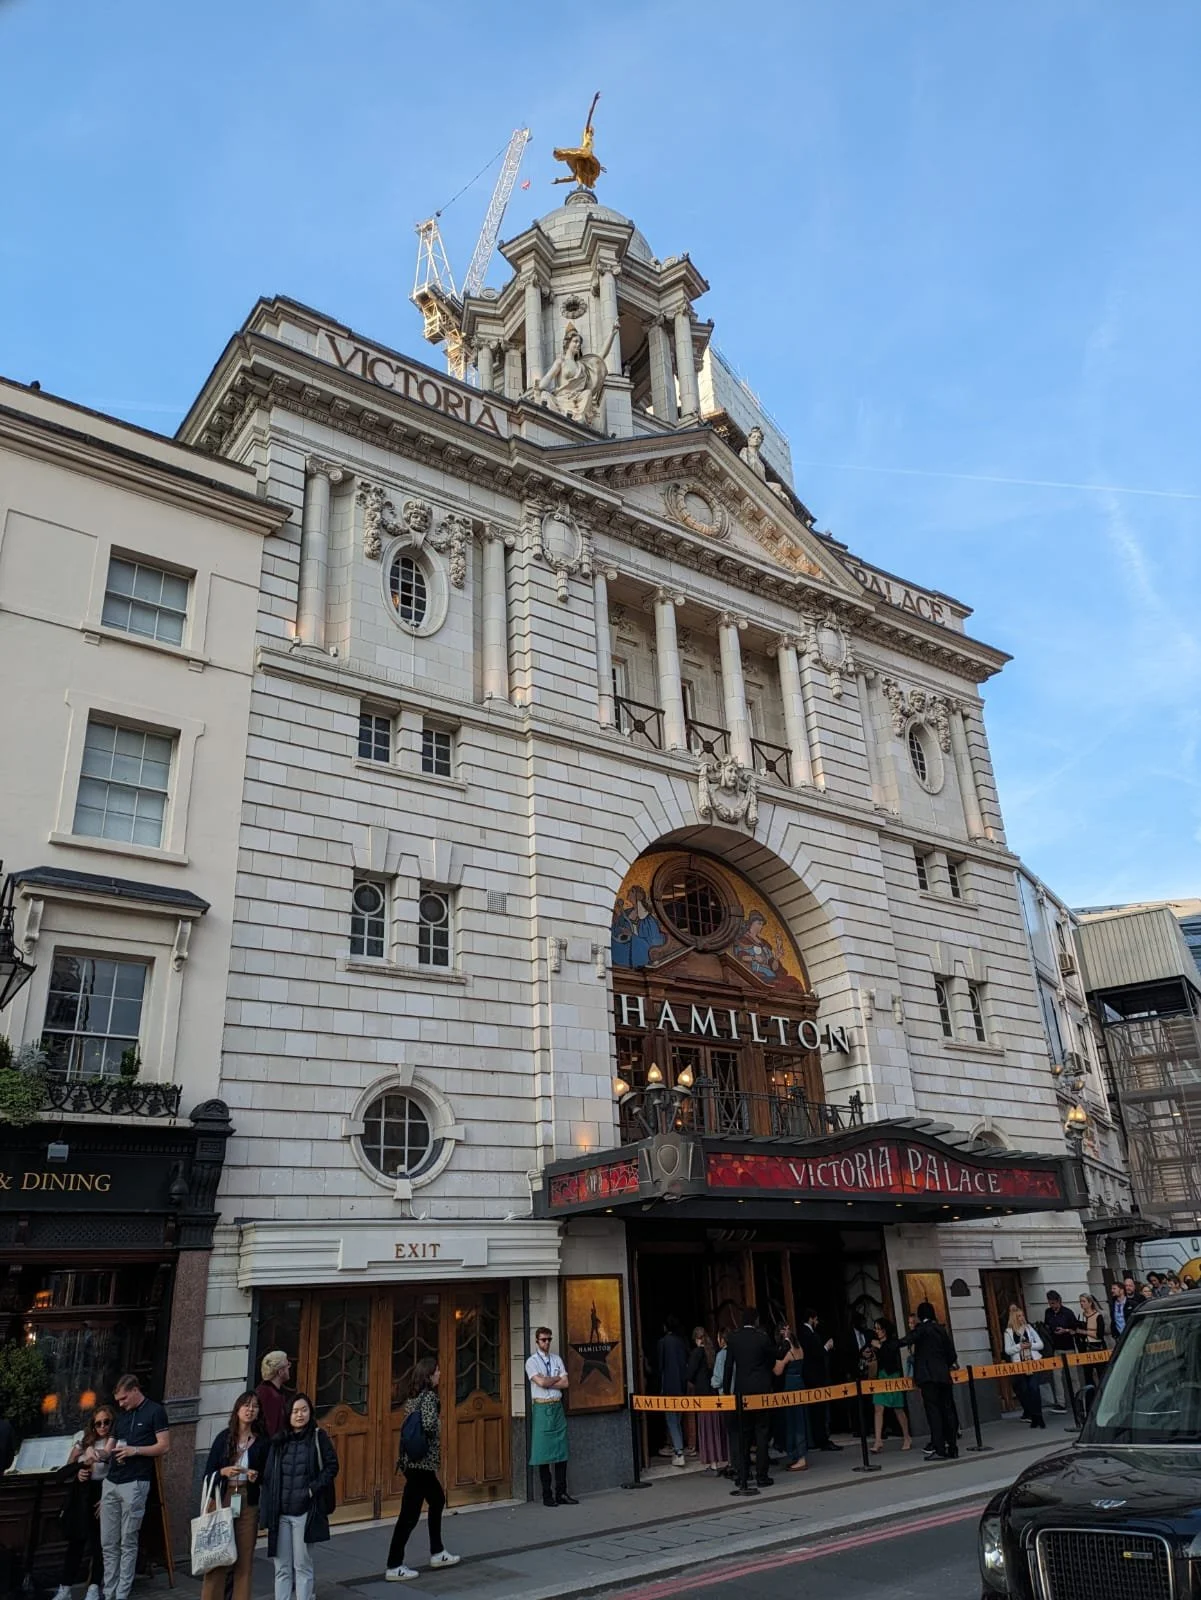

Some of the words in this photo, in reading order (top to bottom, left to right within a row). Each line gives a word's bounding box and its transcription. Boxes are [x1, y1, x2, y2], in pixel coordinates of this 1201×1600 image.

[325, 334, 500, 435] VICTORIA
[853, 567, 945, 626] PALACE
[619, 994, 850, 1055] HAMILTON
[788, 1146, 893, 1188] VICTORIA
[908, 1148, 1001, 1192] PALACE
[20, 1172, 112, 1192] DINING
[394, 1243, 441, 1258] EXIT
[578, 1344, 612, 1353] HAMILTON
[994, 1359, 1046, 1376] HAMILTON
[884, 1379, 914, 1392] HAM
[634, 1397, 702, 1408] AMILTON
[760, 1387, 833, 1407] HAMILTON
